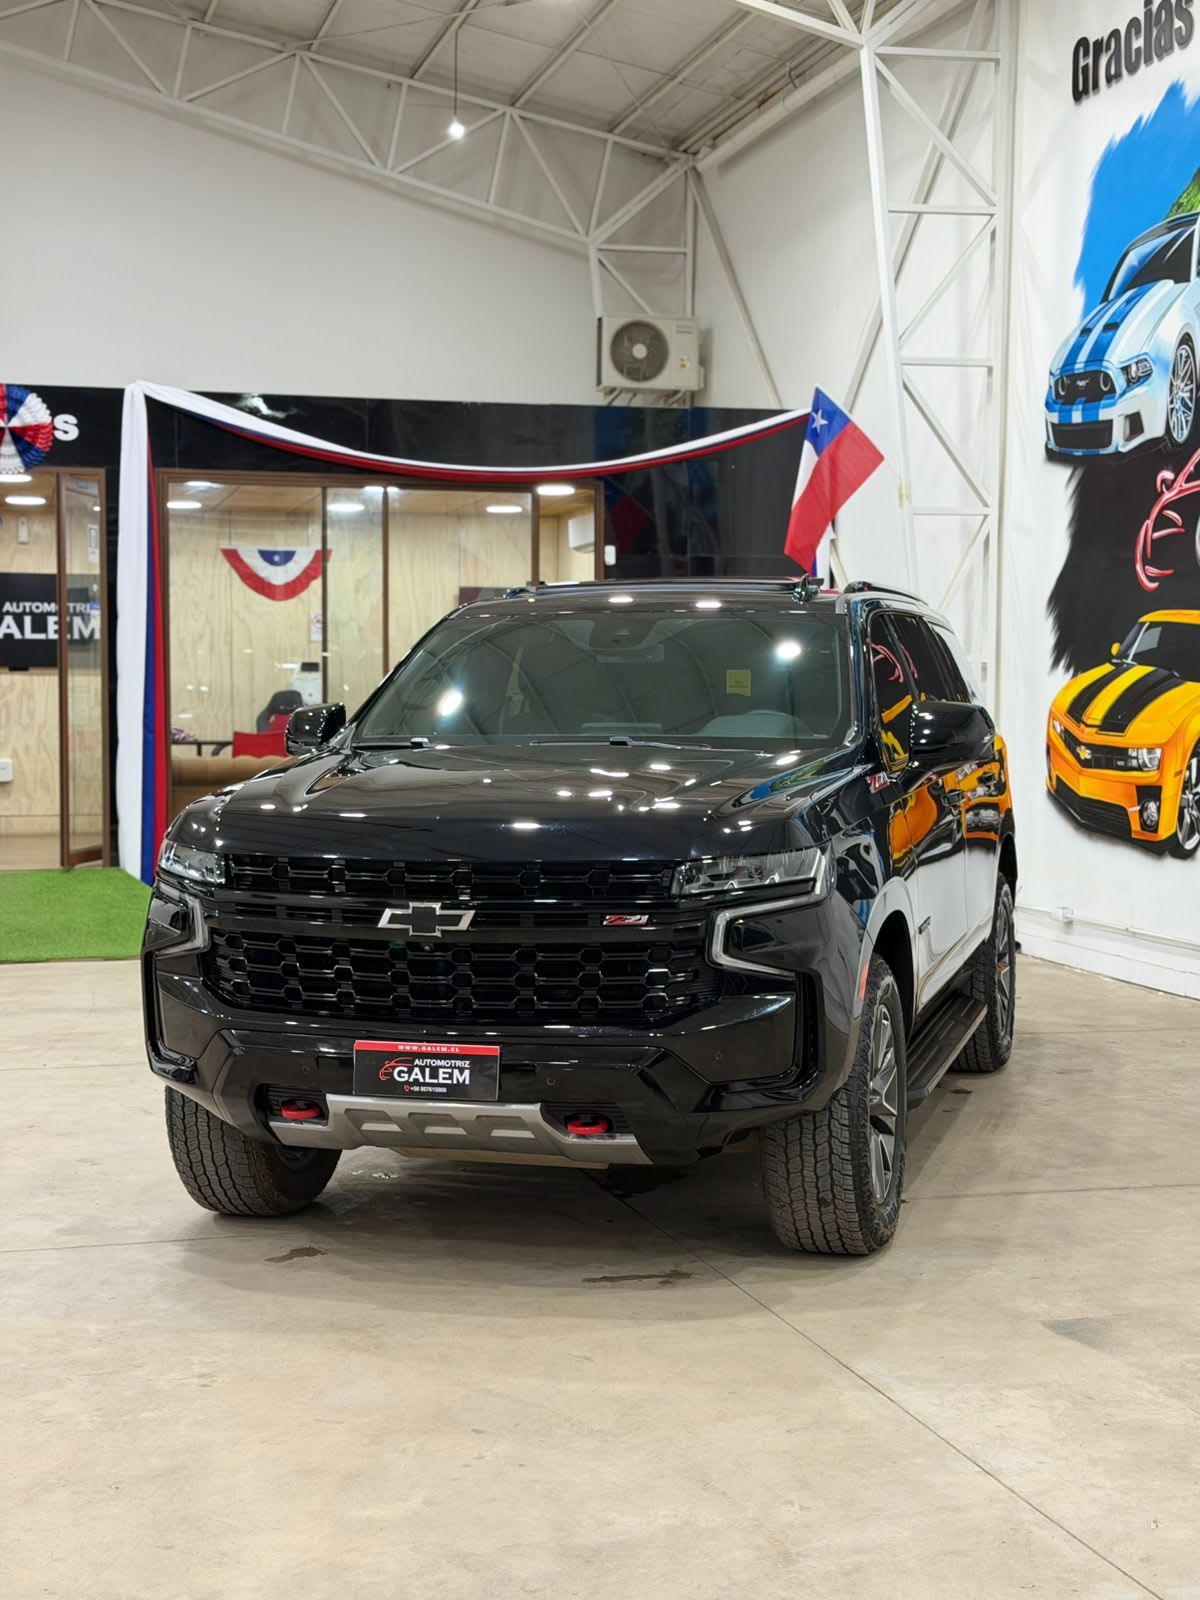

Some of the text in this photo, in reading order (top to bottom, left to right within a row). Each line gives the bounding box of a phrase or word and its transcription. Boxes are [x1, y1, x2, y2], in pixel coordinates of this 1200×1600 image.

[1072, 0, 1194, 103] Gracias
[413, 1058, 470, 1068] AUTOMOTRIZ
[393, 1067, 470, 1085] GALEM
